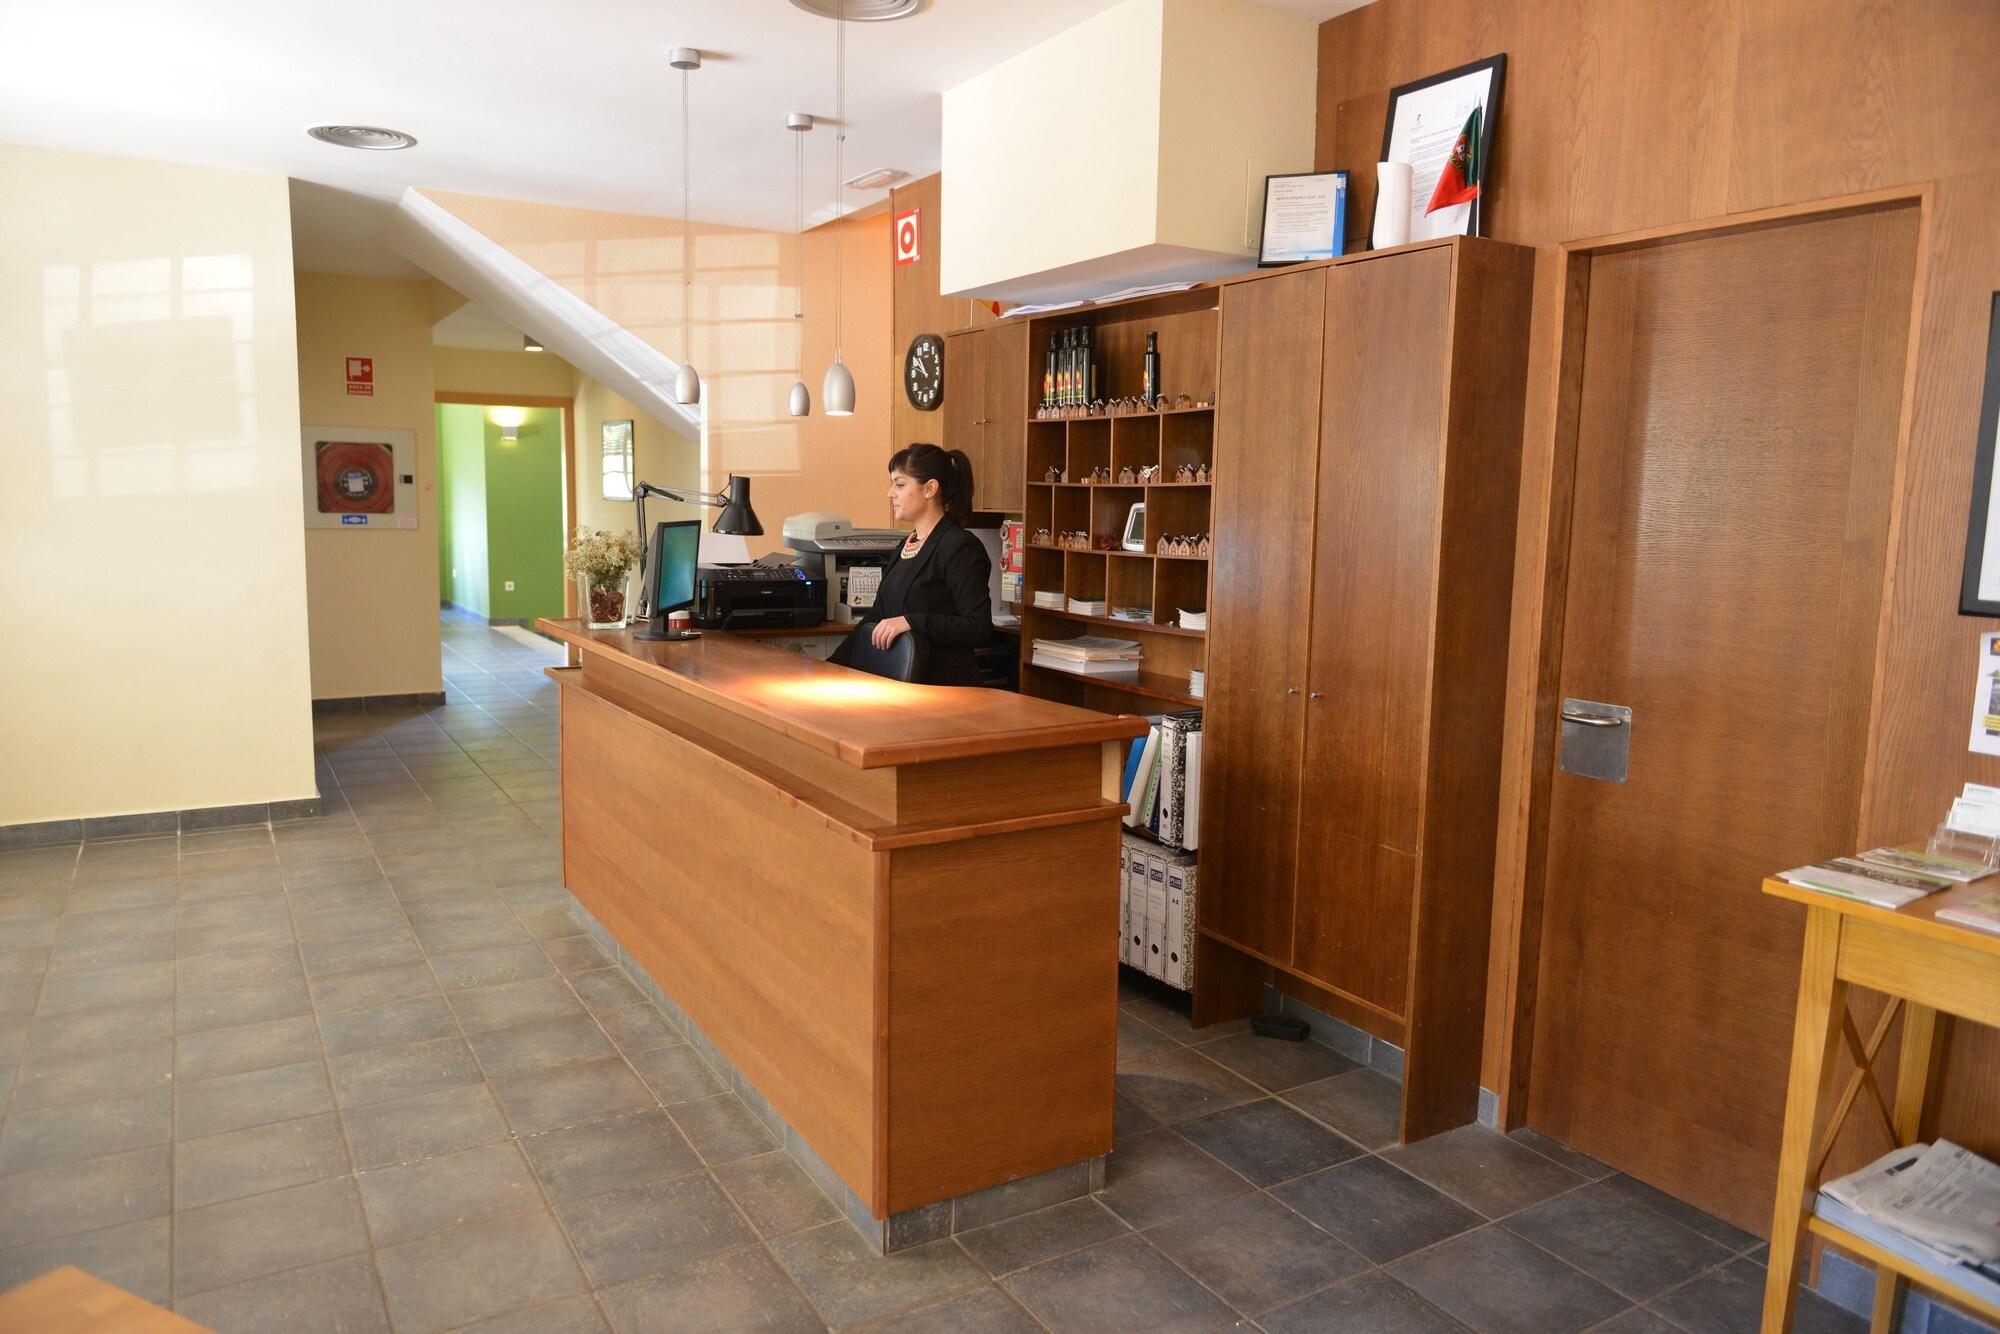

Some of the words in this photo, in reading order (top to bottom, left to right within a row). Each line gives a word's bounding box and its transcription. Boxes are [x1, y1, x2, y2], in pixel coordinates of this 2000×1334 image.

[917, 346, 922, 356] 11
[922, 342, 930, 351] 12
[931, 346, 935, 355] 1
[934, 354, 939, 363] 2
[936, 366, 940, 375] 3
[934, 380, 938, 389] 4
[917, 391, 922, 400] 7
[923, 394, 928, 403] 6
[929, 390, 934, 399] 5
